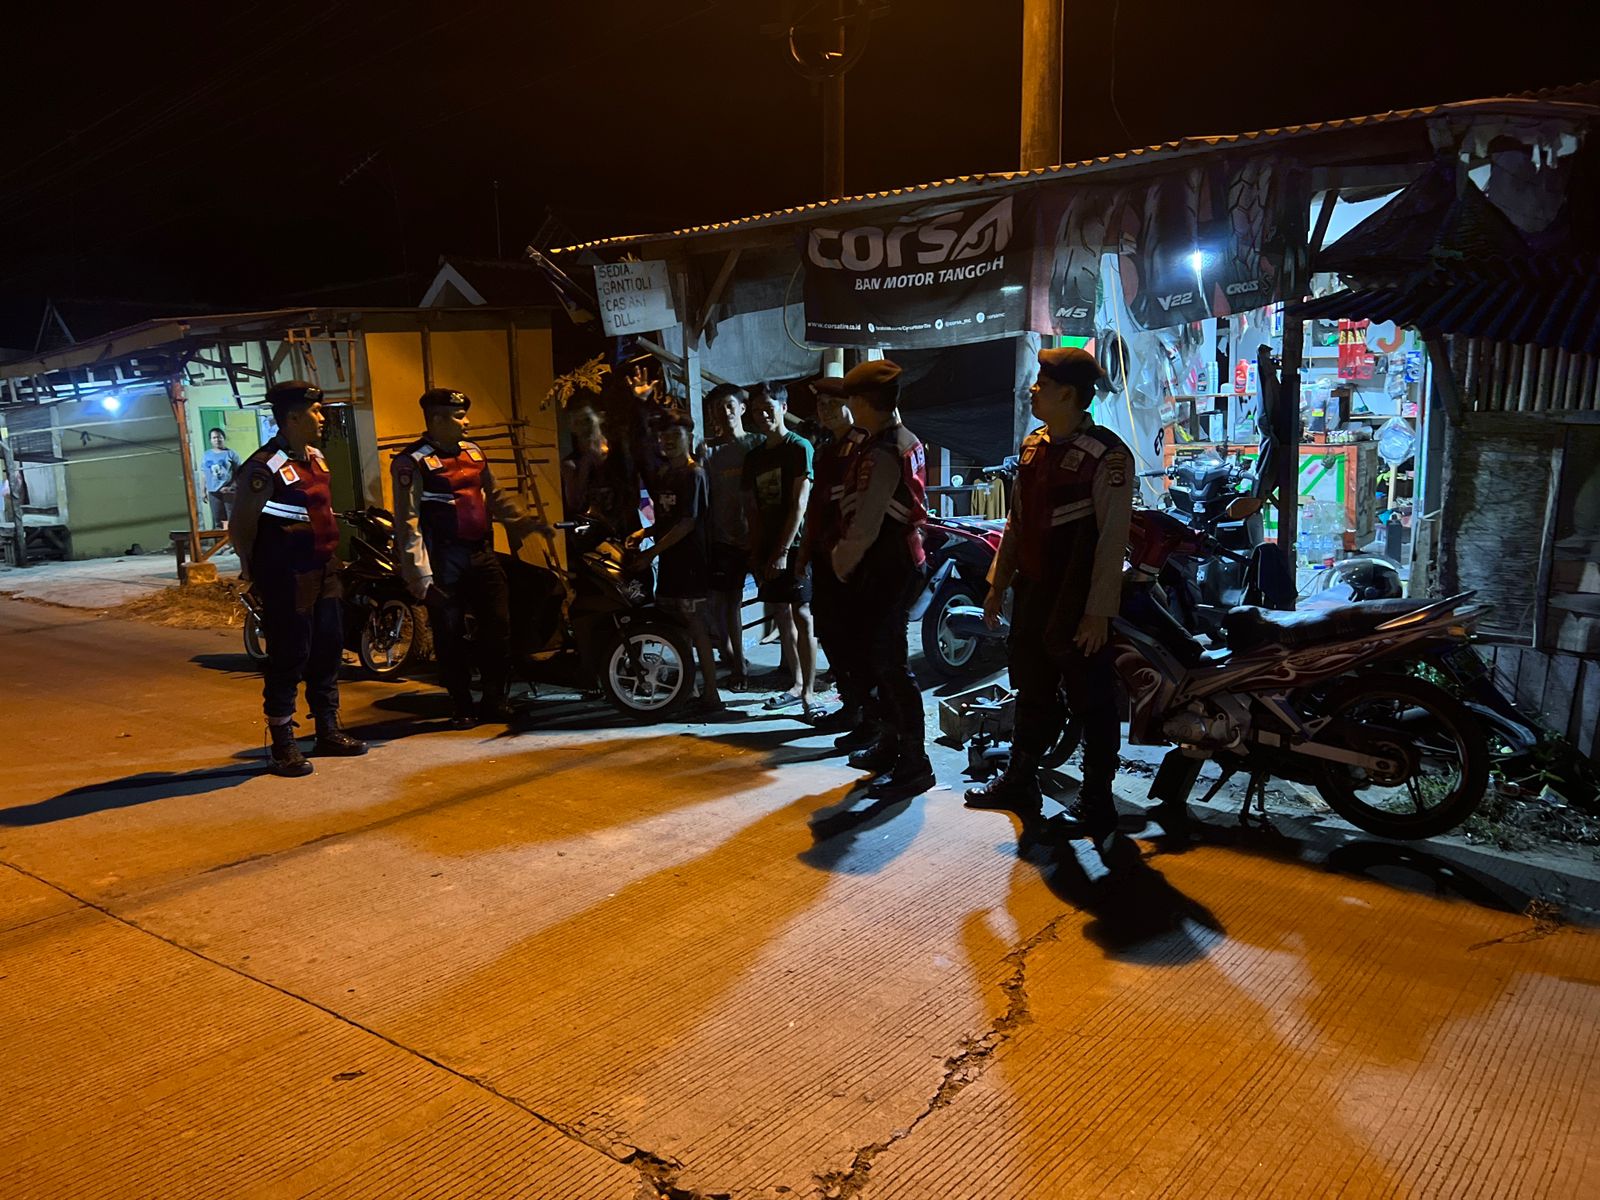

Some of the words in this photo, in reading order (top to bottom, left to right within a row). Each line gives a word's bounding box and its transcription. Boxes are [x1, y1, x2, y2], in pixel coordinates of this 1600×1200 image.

[854, 276, 881, 292] BAN
[883, 271, 934, 289] MOTOR
[1226, 279, 1259, 296] CROSS
[1156, 292, 1193, 312] V22
[1055, 305, 1089, 319] M5
